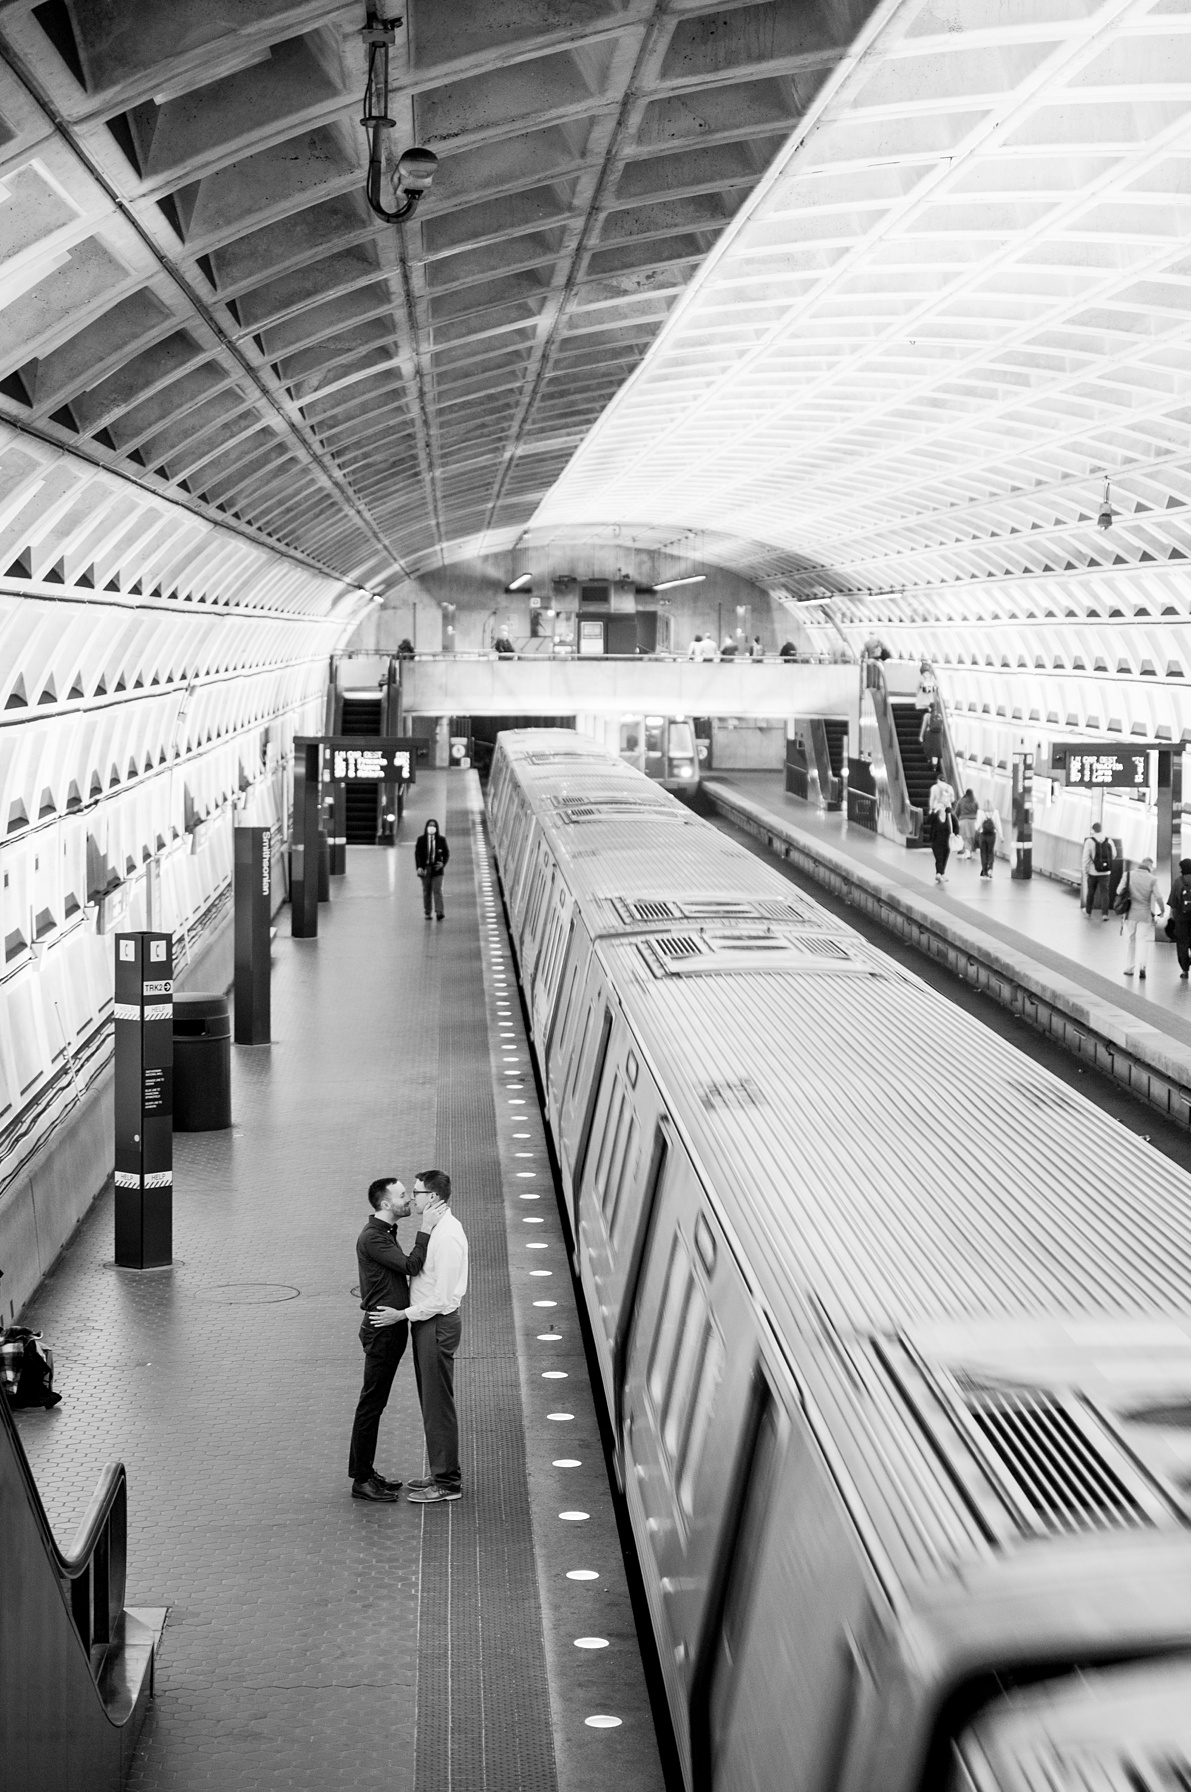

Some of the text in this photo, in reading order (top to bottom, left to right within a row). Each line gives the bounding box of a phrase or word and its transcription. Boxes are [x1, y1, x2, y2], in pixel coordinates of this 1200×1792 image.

[262, 831, 271, 896] Smithsonian
[145, 984, 163, 992] TRK2
[151, 1005, 166, 1013] HELP
[151, 1173, 166, 1181] HELP
